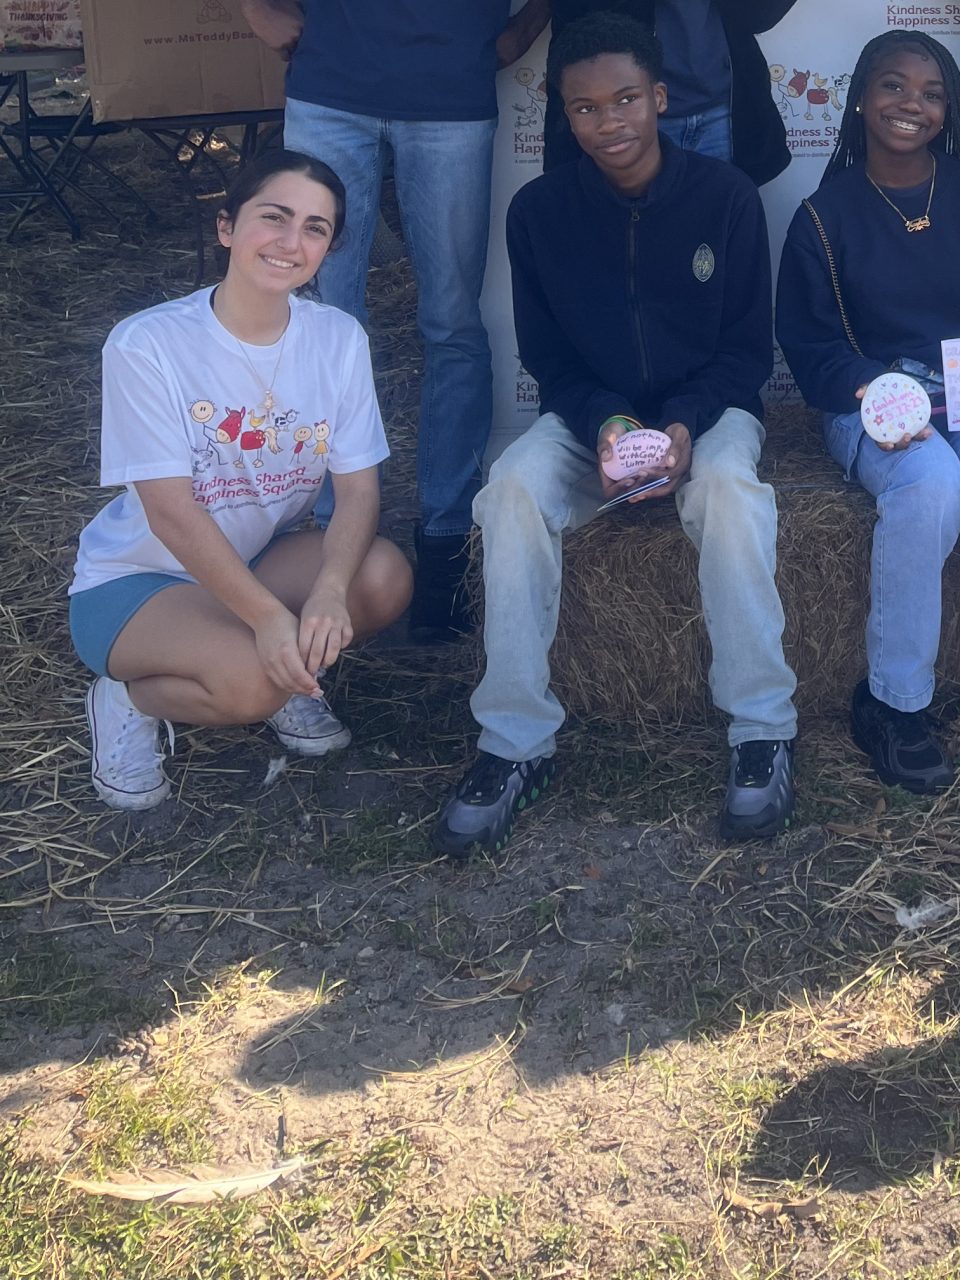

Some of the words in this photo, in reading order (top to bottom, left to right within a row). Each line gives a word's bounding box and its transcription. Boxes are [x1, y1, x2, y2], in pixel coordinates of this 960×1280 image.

[886, 5, 941, 15] Kindness
[9, 12, 68, 21] THANKSGIVING
[886, 15, 949, 28] Happiness
[144, 31, 258, 45] www.MsTeddyBea
[514, 132, 544, 142] Kind
[786, 127, 821, 137] dness
[786, 138, 830, 150] piness
[255, 466, 306, 486] Shared
[193, 488, 260, 506] appiness
[262, 476, 322, 496] Squared
